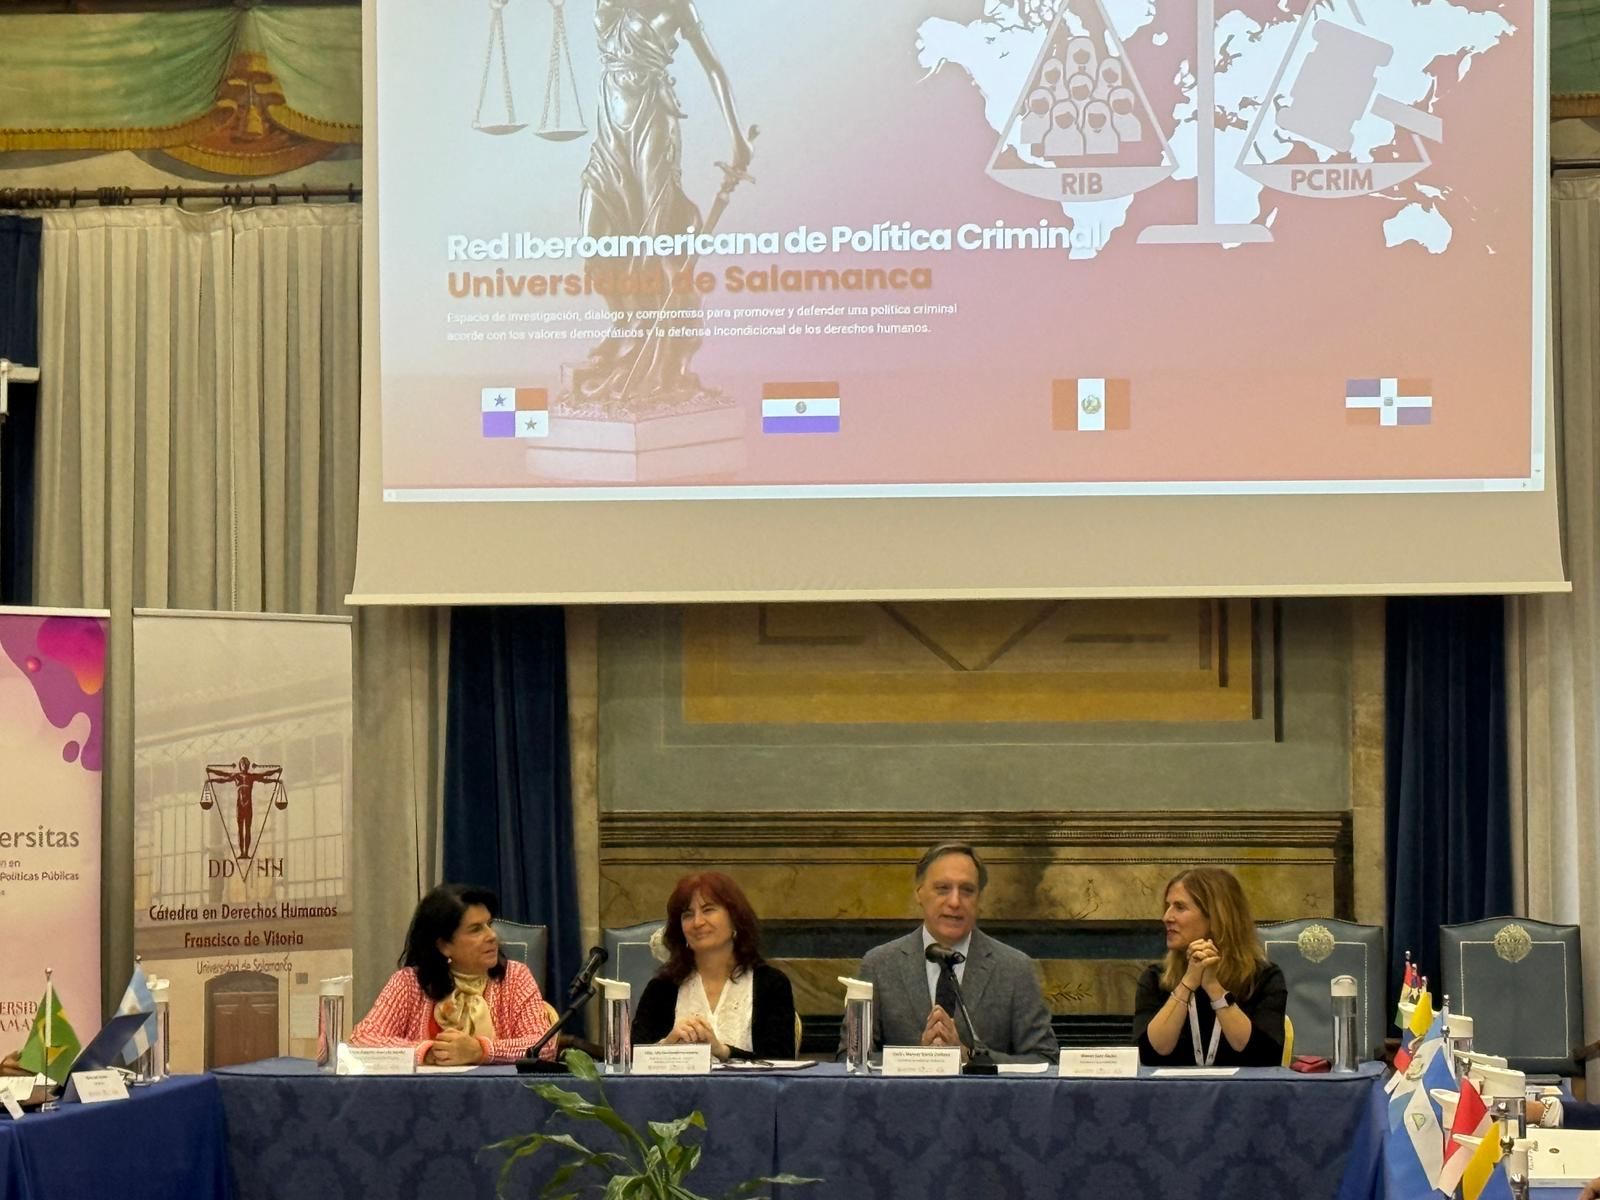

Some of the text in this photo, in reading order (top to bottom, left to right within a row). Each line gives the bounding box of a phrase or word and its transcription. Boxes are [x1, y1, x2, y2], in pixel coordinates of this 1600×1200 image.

[1062, 173, 1103, 195] RIB
[1291, 168, 1373, 191] PCRIM
[447, 219, 1101, 261] Red Iberoamericana de Política Criminal
[671, 265, 716, 295] de
[725, 264, 932, 294] Salamanca
[447, 312, 490, 325] Espacio
[492, 311, 506, 322] de
[626, 311, 633, 323] y
[635, 309, 703, 321] compromiso
[707, 309, 730, 321] para
[734, 308, 785, 320] promover
[788, 307, 795, 319] y
[797, 304, 844, 317] defender
[848, 306, 868, 315] una
[914, 304, 957, 315] criminal
[447, 330, 484, 342] acorde
[487, 331, 506, 341] con
[510, 330, 525, 340] los
[528, 329, 567, 341] valores
[655, 327, 664, 337] la
[668, 326, 711, 337] defensa
[714, 325, 785, 336] incondicional
[789, 324, 802, 335] de
[805, 324, 821, 335] los
[824, 323, 874, 334] derechos
[877, 323, 931, 333] humanos.
[149, 902, 337, 921] Cátedra en Derechos Humanos
[184, 930, 304, 948] Francisco de Vitoria
[197, 960, 240, 975] Universidad
